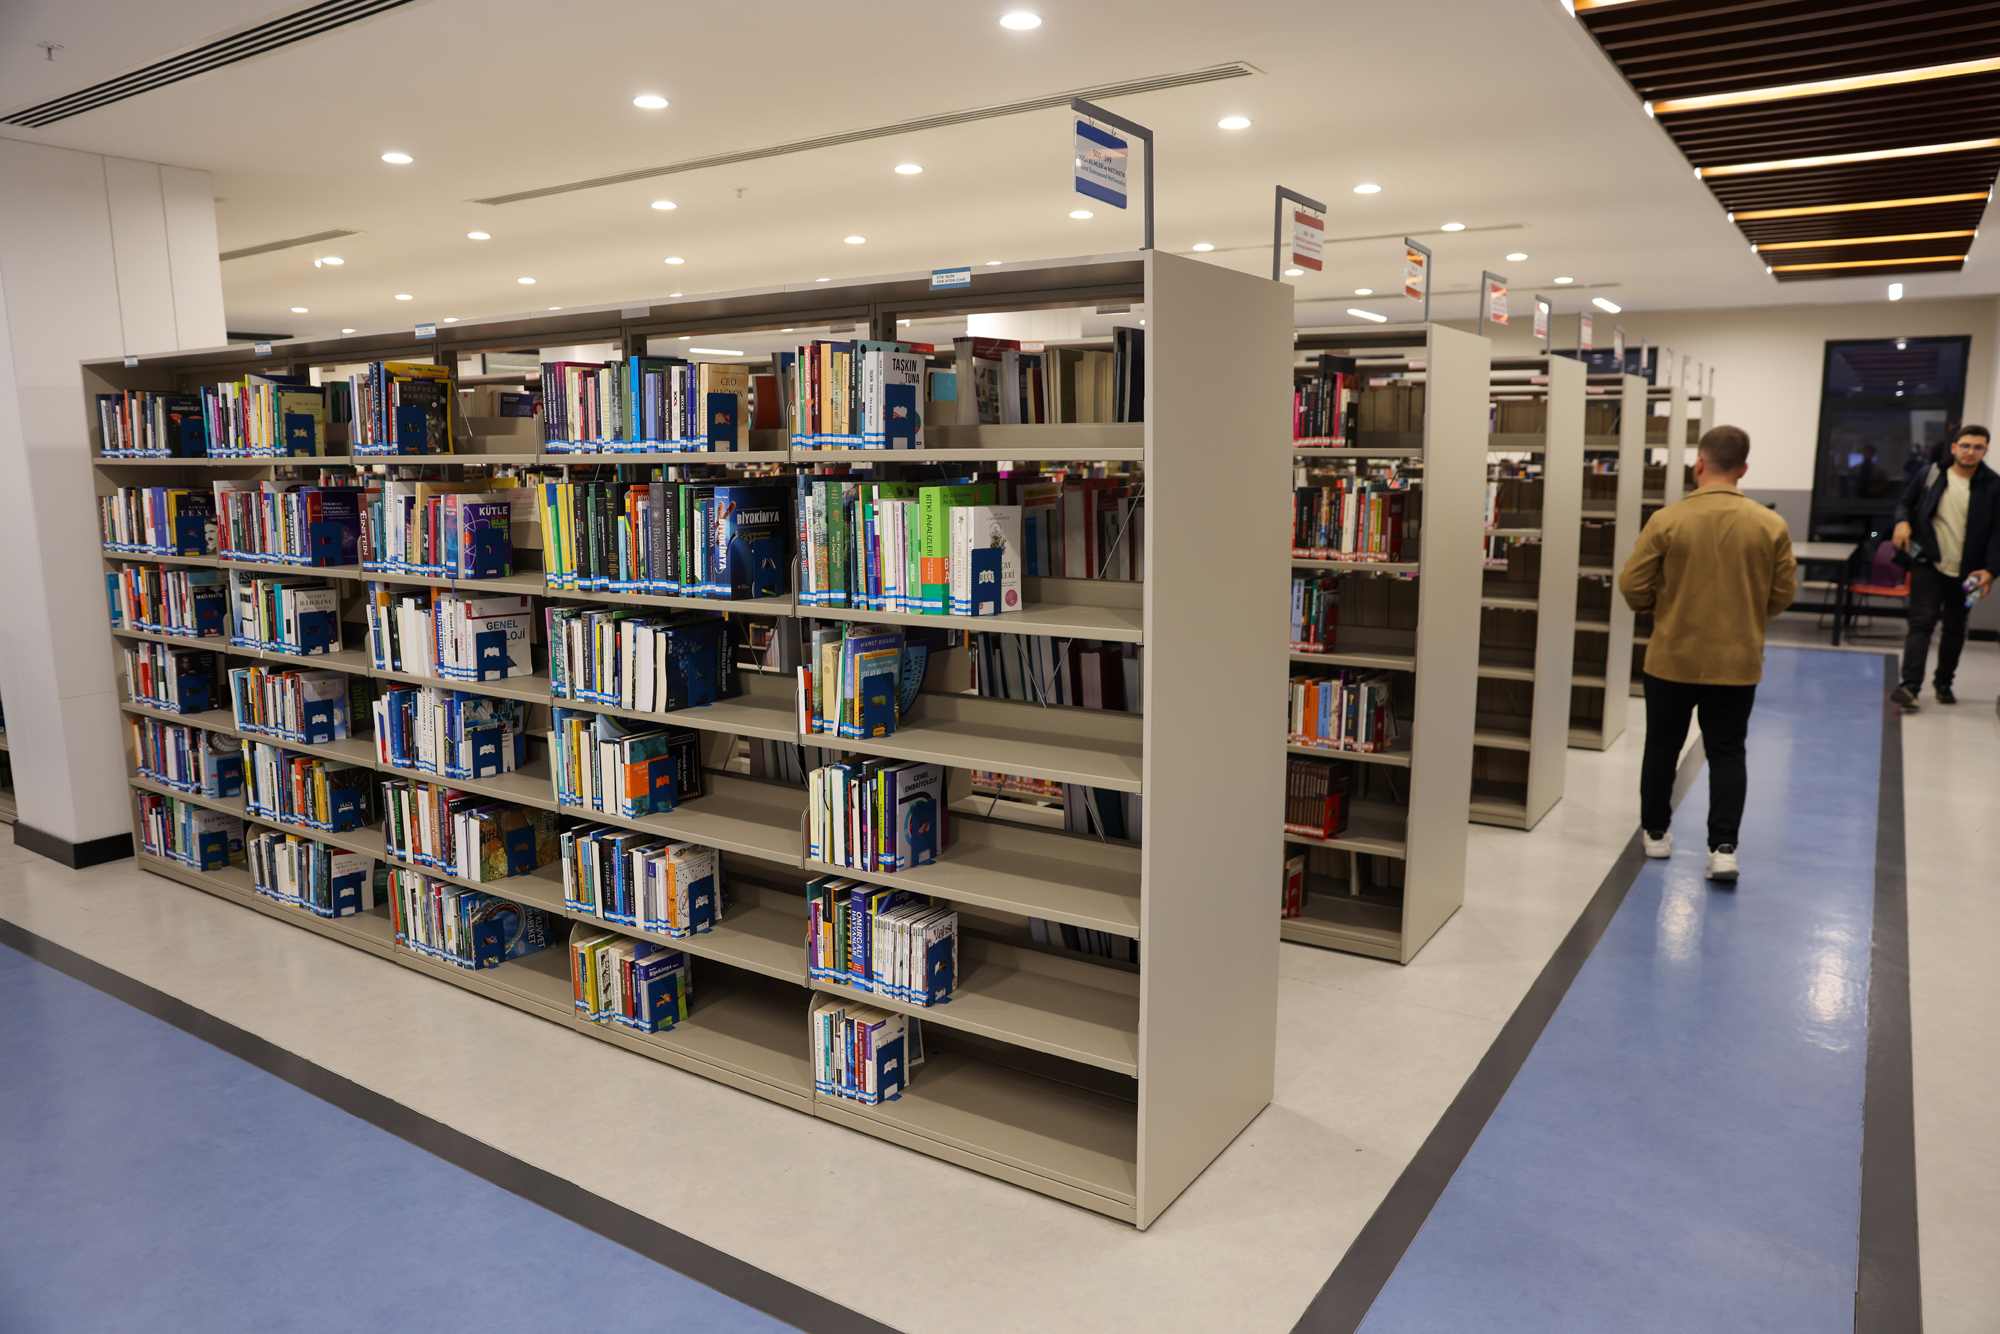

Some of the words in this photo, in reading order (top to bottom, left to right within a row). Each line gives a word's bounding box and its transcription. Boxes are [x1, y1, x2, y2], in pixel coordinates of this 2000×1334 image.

[892, 358, 918, 375] TAŞKIN
[720, 377, 738, 387] CRO
[904, 373, 920, 384] TUNA
[402, 384, 437, 393] STEPHEN
[402, 393, 437, 401] HAWKING
[479, 505, 508, 517] KÜTLE
[925, 494, 933, 512] BİTKİ
[736, 510, 780, 526] BİYOKİMYA
[359, 510, 369, 556] EINSTEIN
[926, 514, 934, 558] ANALİZLERİ
[653, 527, 662, 578] Biyokimya
[718, 519, 728, 570] BİYOKİMYA
[299, 598, 334, 607] HAWKING
[486, 619, 519, 631] GENEL
[860, 640, 878, 649] HİKMET
[904, 774, 938, 793] EMBRİYOLOJİ
[913, 771, 930, 782] GENEL
[540, 810, 550, 840] Kimya
[525, 908, 536, 944] HAREKET
[535, 915, 546, 948] KUVVET
[855, 911, 863, 959] OMURGALI
[649, 965, 672, 977] Biyokimya
